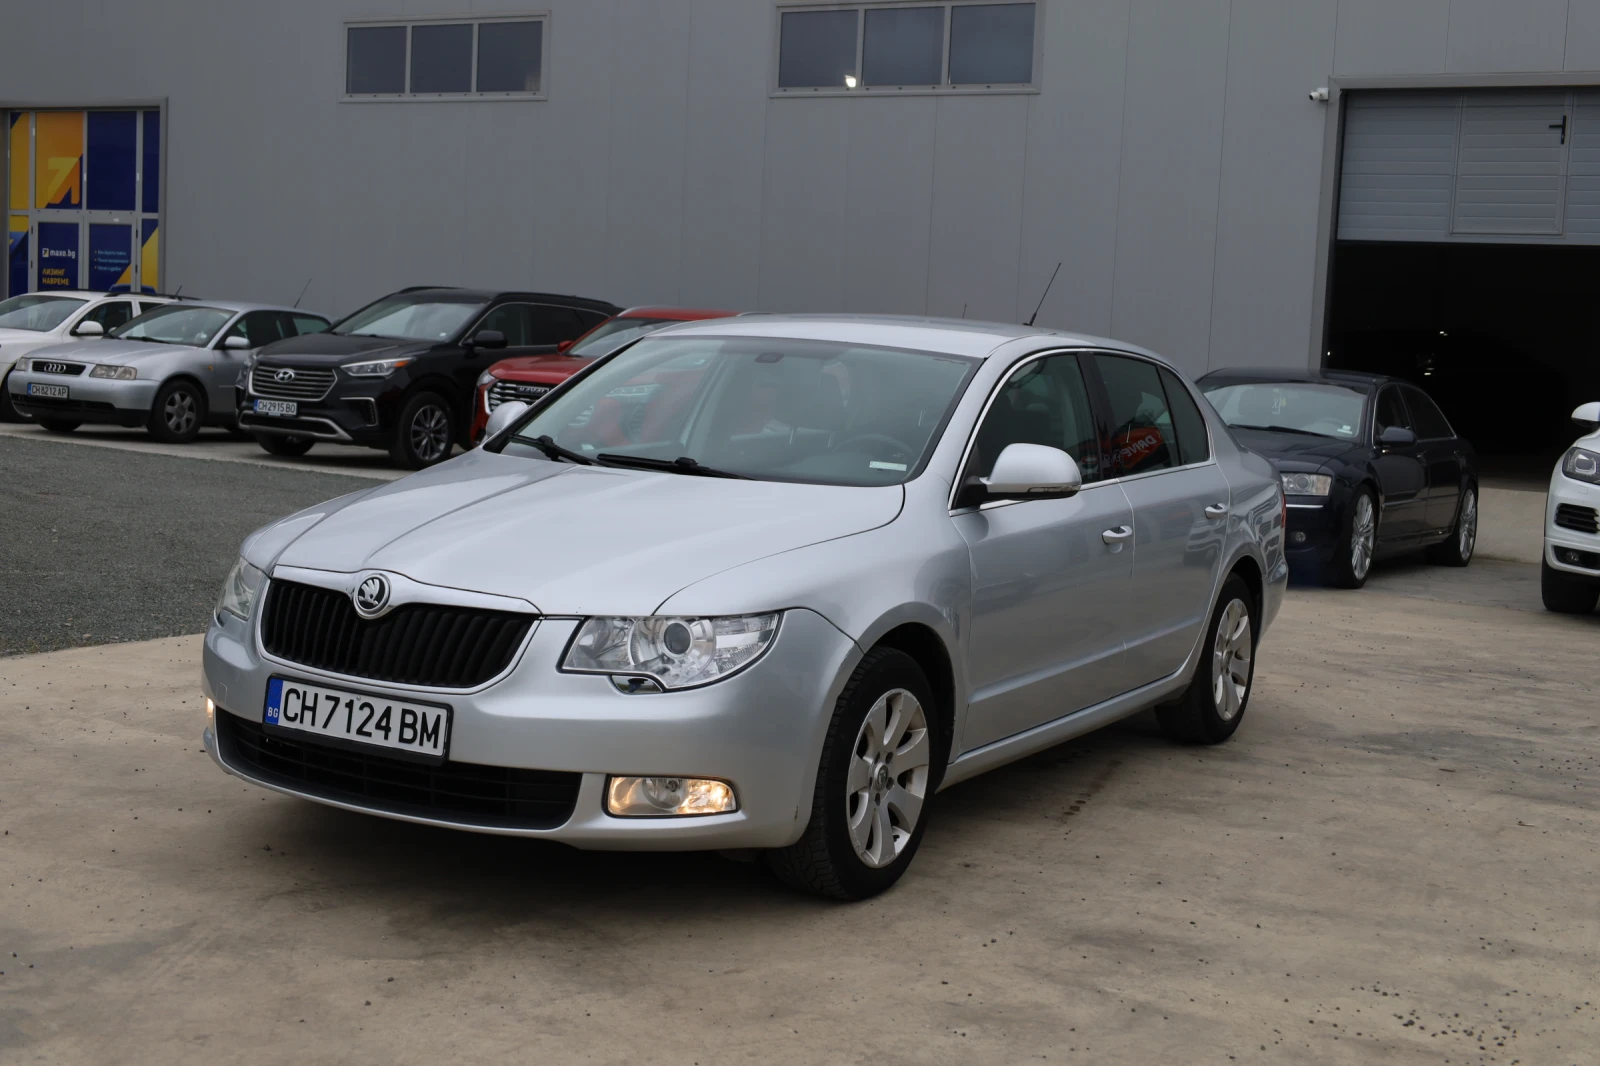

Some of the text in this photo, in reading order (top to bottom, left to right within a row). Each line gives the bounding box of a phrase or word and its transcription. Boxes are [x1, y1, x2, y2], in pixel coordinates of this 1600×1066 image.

[50, 248, 76, 259] maxo.bg
[42, 268, 65, 276] ЛИЗИНГ
[42, 277, 70, 286] НАВРЕМЕ
[267, 706, 279, 718] BG
